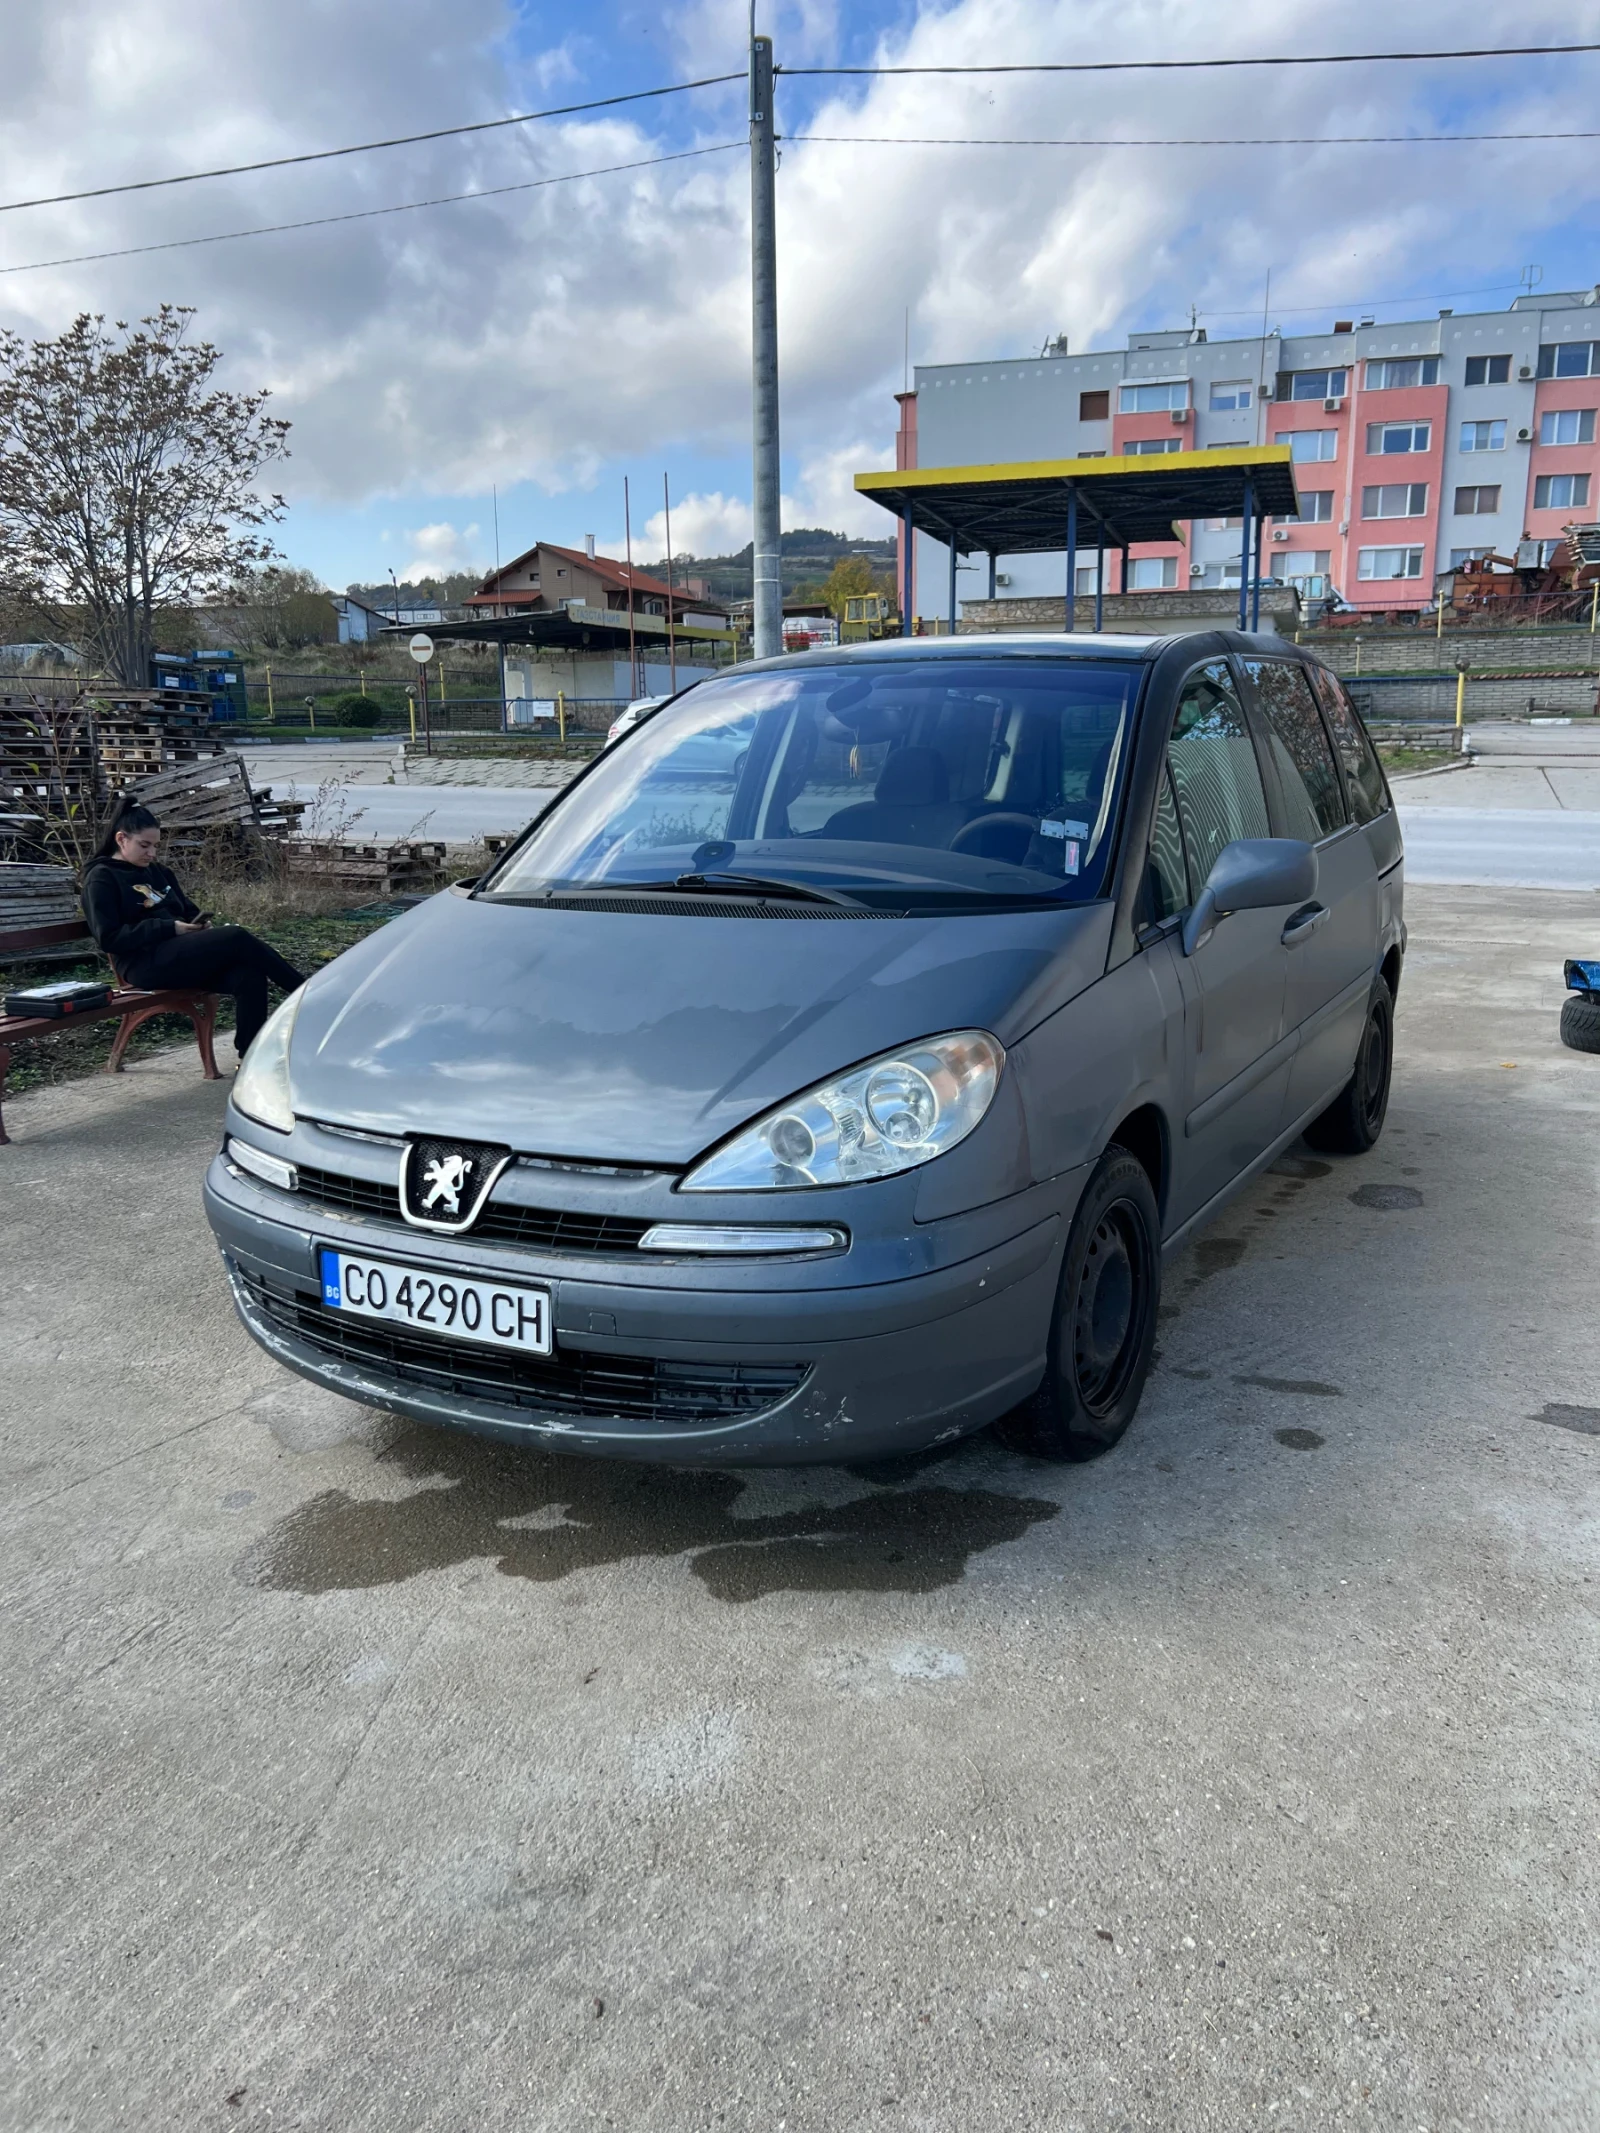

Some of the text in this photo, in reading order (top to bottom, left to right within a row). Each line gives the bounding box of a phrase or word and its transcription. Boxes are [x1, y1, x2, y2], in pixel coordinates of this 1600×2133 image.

[326, 1284, 340, 1299] BG
[345, 1263, 542, 1344] CO 4290 CH
